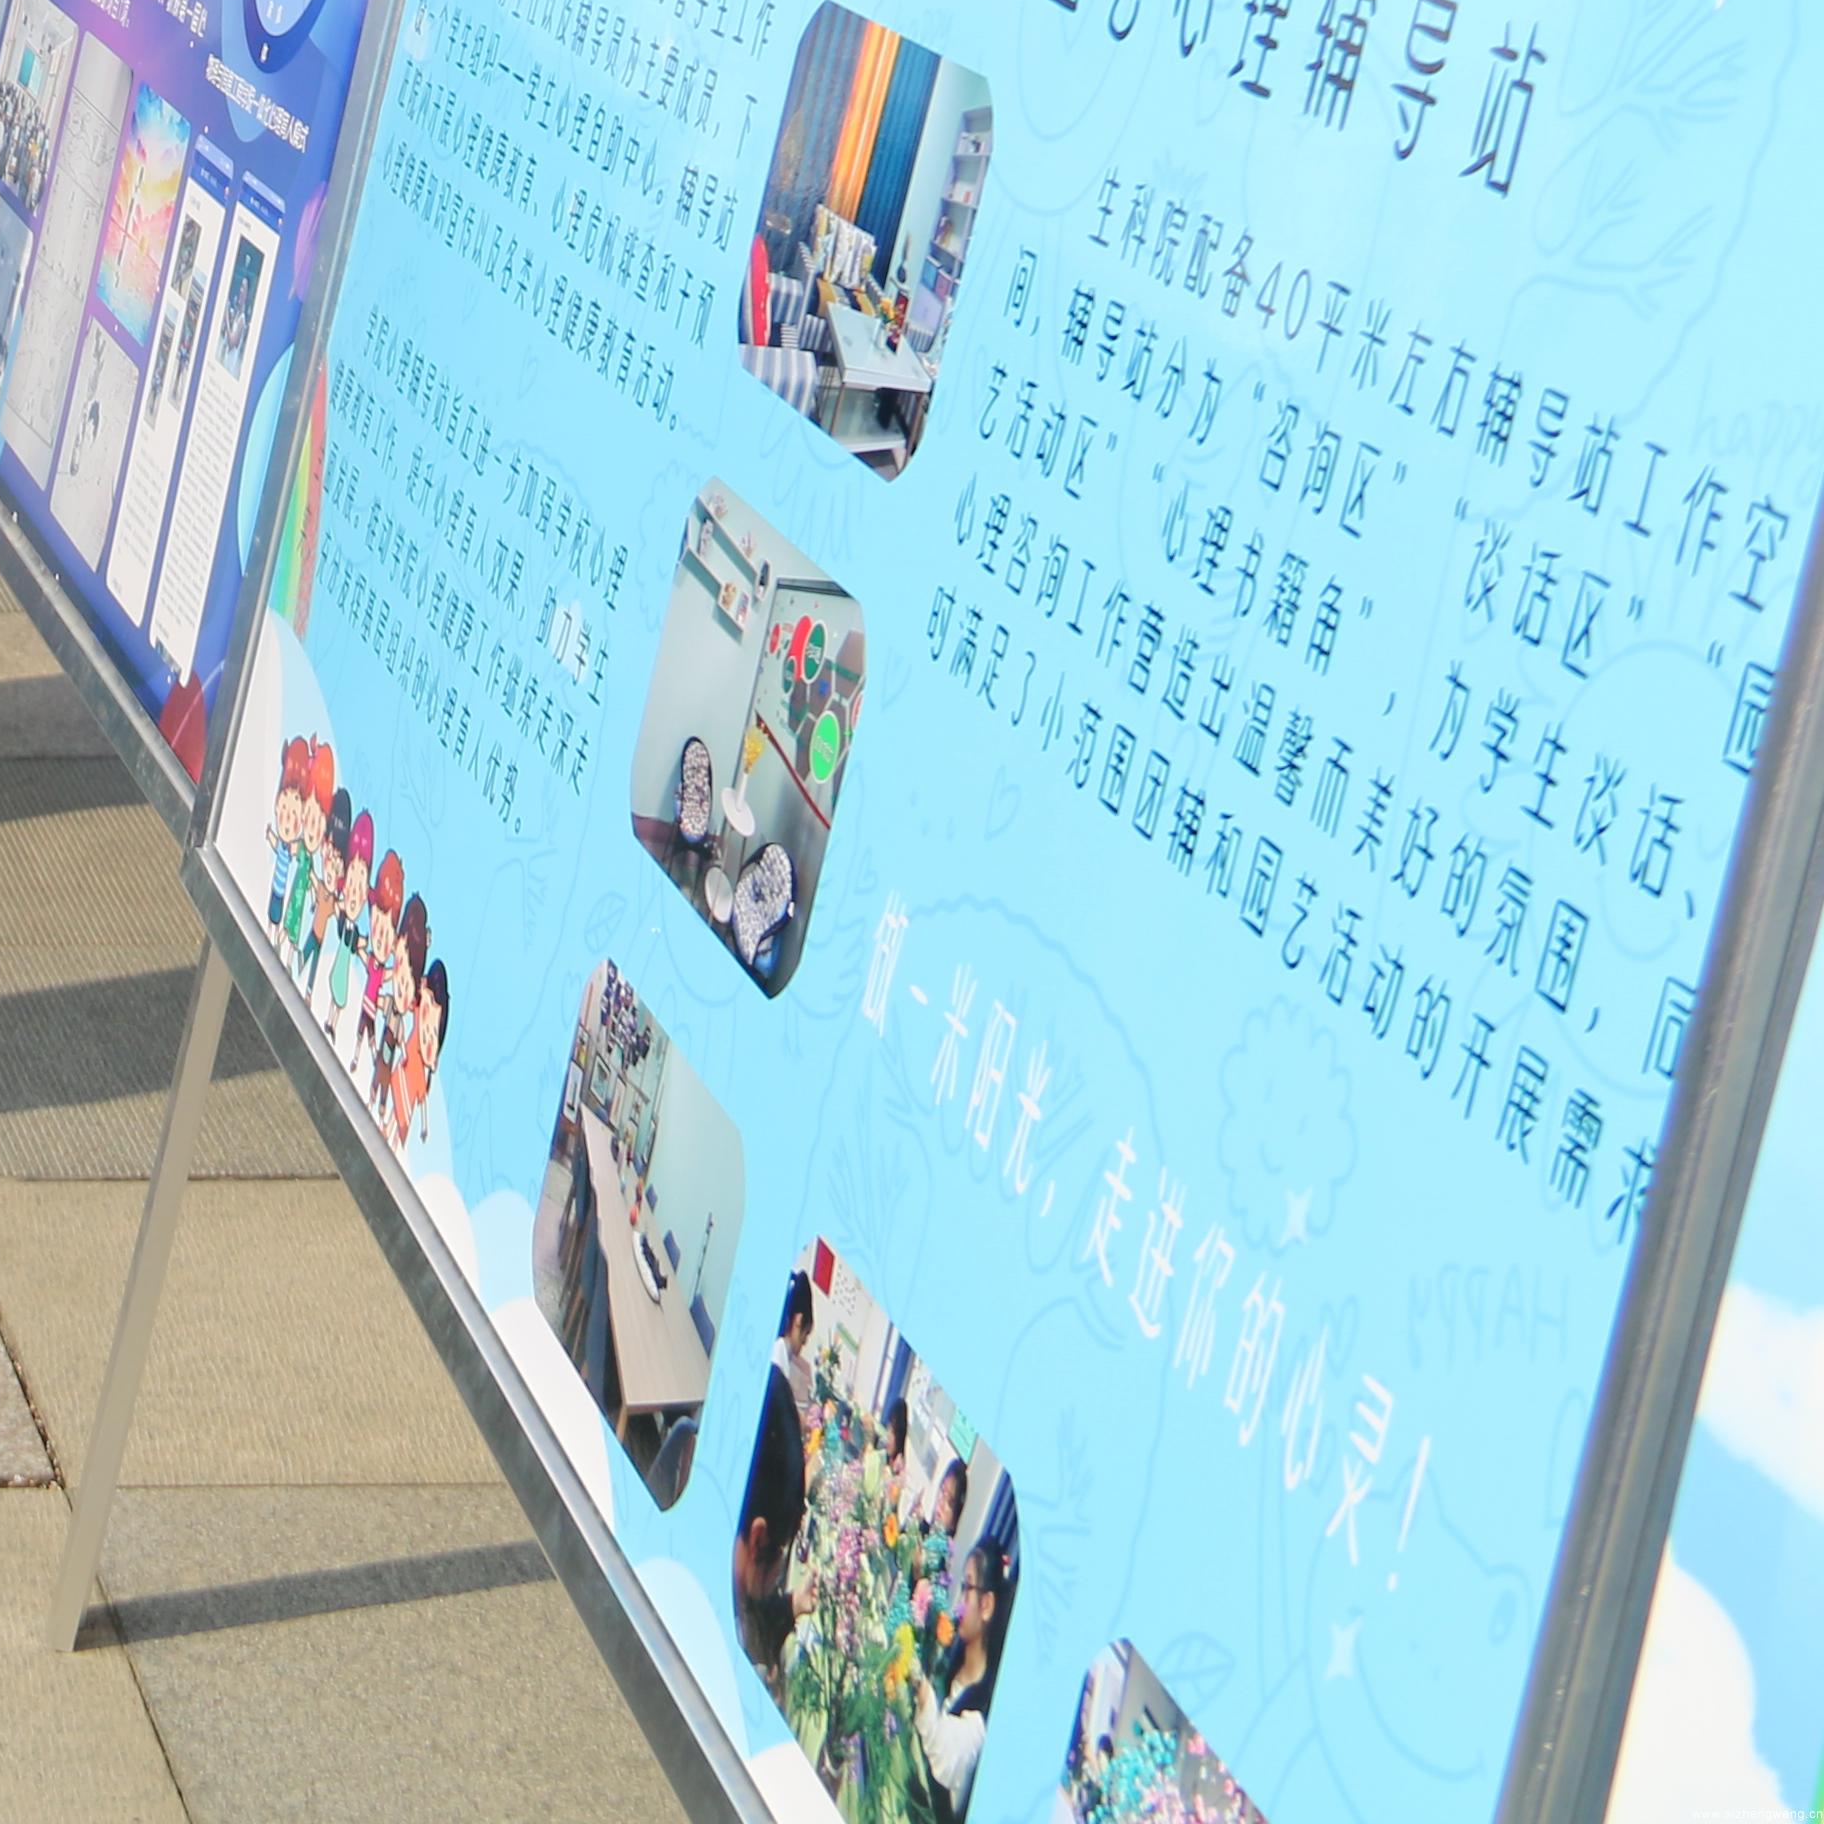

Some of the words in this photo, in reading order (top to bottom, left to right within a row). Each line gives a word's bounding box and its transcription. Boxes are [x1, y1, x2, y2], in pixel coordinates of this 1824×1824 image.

[1087, 166, 1789, 613] 生科院配备40平米左右辅导站工作空
